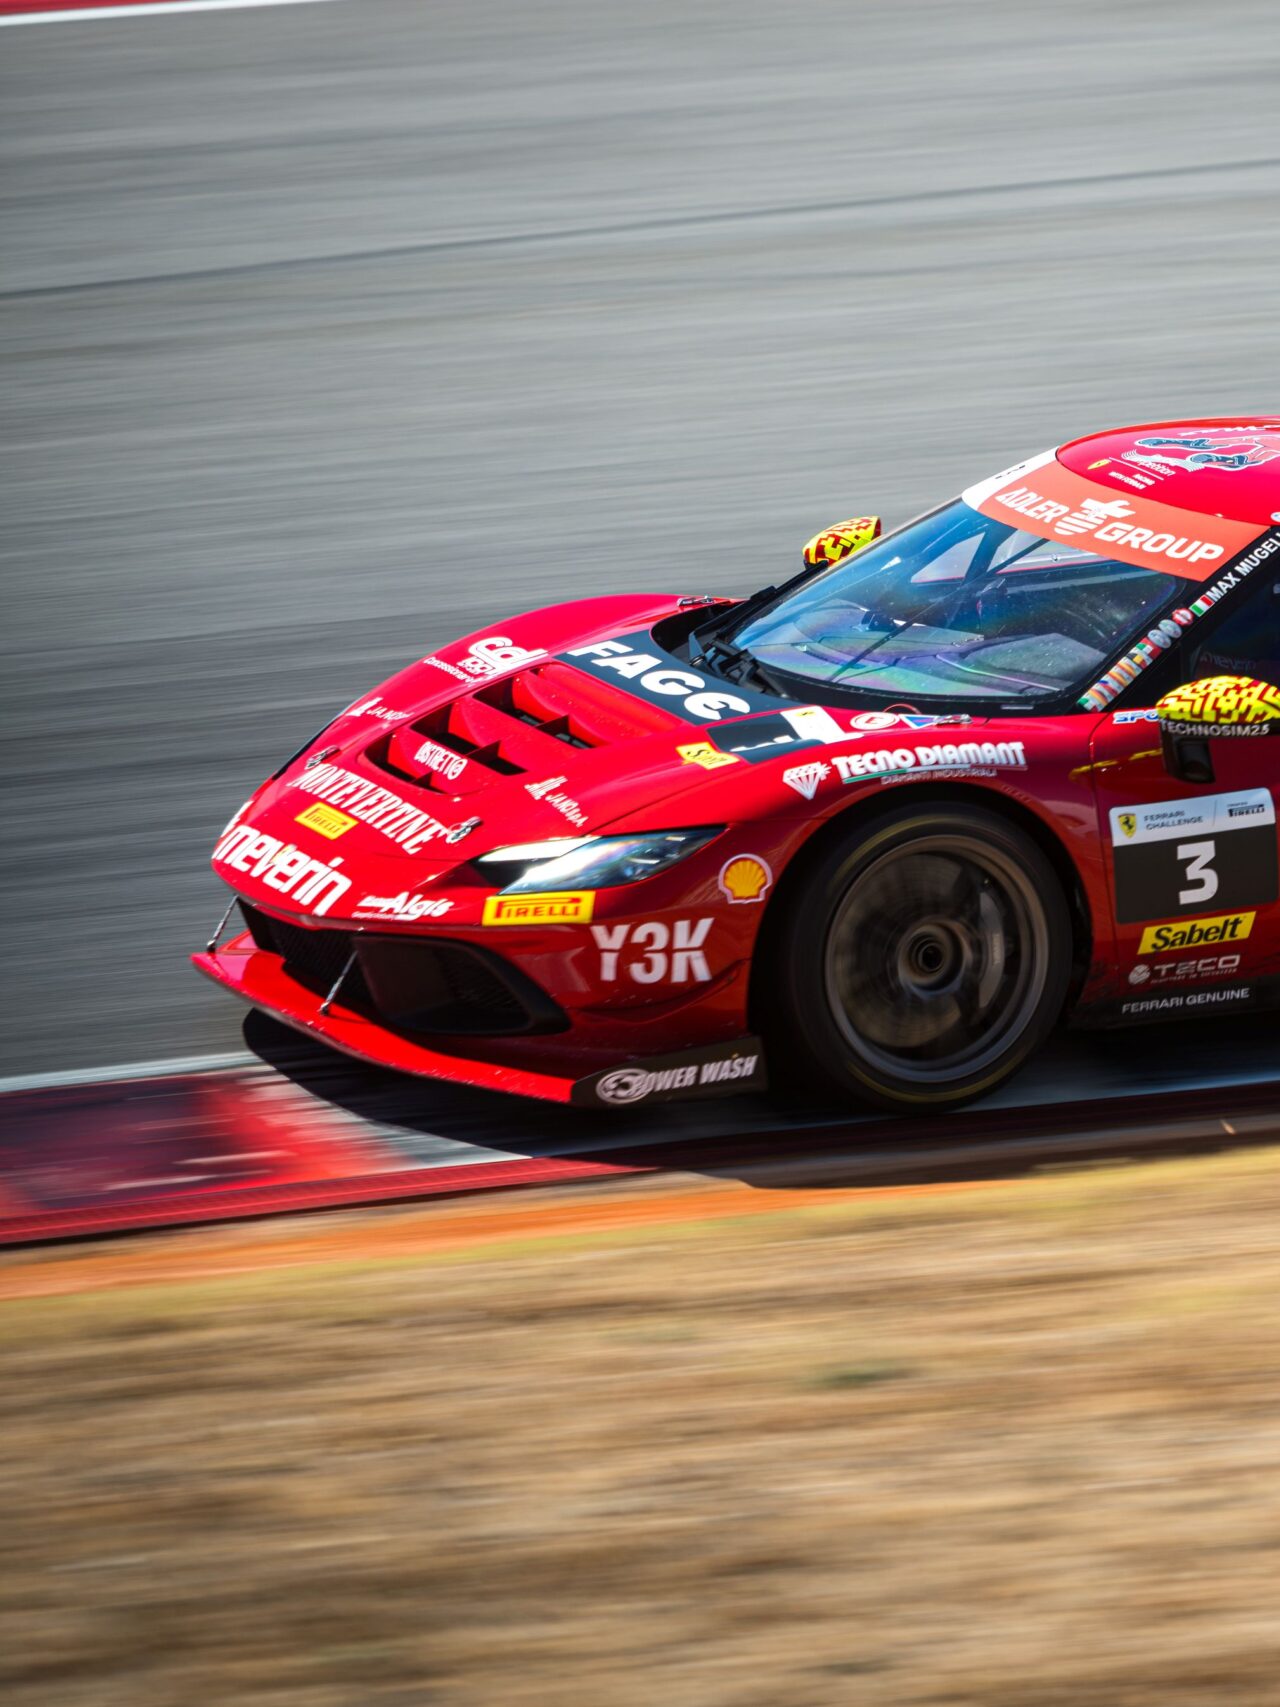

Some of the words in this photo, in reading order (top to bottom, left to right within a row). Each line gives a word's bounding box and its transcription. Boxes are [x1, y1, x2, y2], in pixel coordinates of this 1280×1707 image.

[995, 487, 1070, 523] ADLER
[1094, 521, 1224, 563] GROUP
[1206, 572, 1241, 603] MAX
[566, 640, 751, 720] FAGE
[1160, 719, 1270, 737] TECHNOSIM25
[831, 748, 917, 779] TECNO
[914, 741, 1025, 767] DIAMANT
[287, 763, 449, 855] MONTEVERTINE
[304, 807, 348, 834] PIRELLI
[1144, 810, 1186, 822] FERRARI
[1146, 816, 1204, 830] CHALLENGE
[1228, 803, 1265, 818] PIRELLI
[211, 824, 352, 916] meverin
[1177, 840, 1219, 905] 3
[493, 897, 582, 919] PIRELLI
[1150, 917, 1244, 950] Sabelt
[590, 917, 715, 984] Y3K
[1154, 954, 1241, 977] TECO
[1122, 997, 1183, 1015] FERRARI
[1185, 987, 1250, 1006] GENUINE
[630, 1065, 699, 1096] POWER
[699, 1055, 758, 1085] WASH
